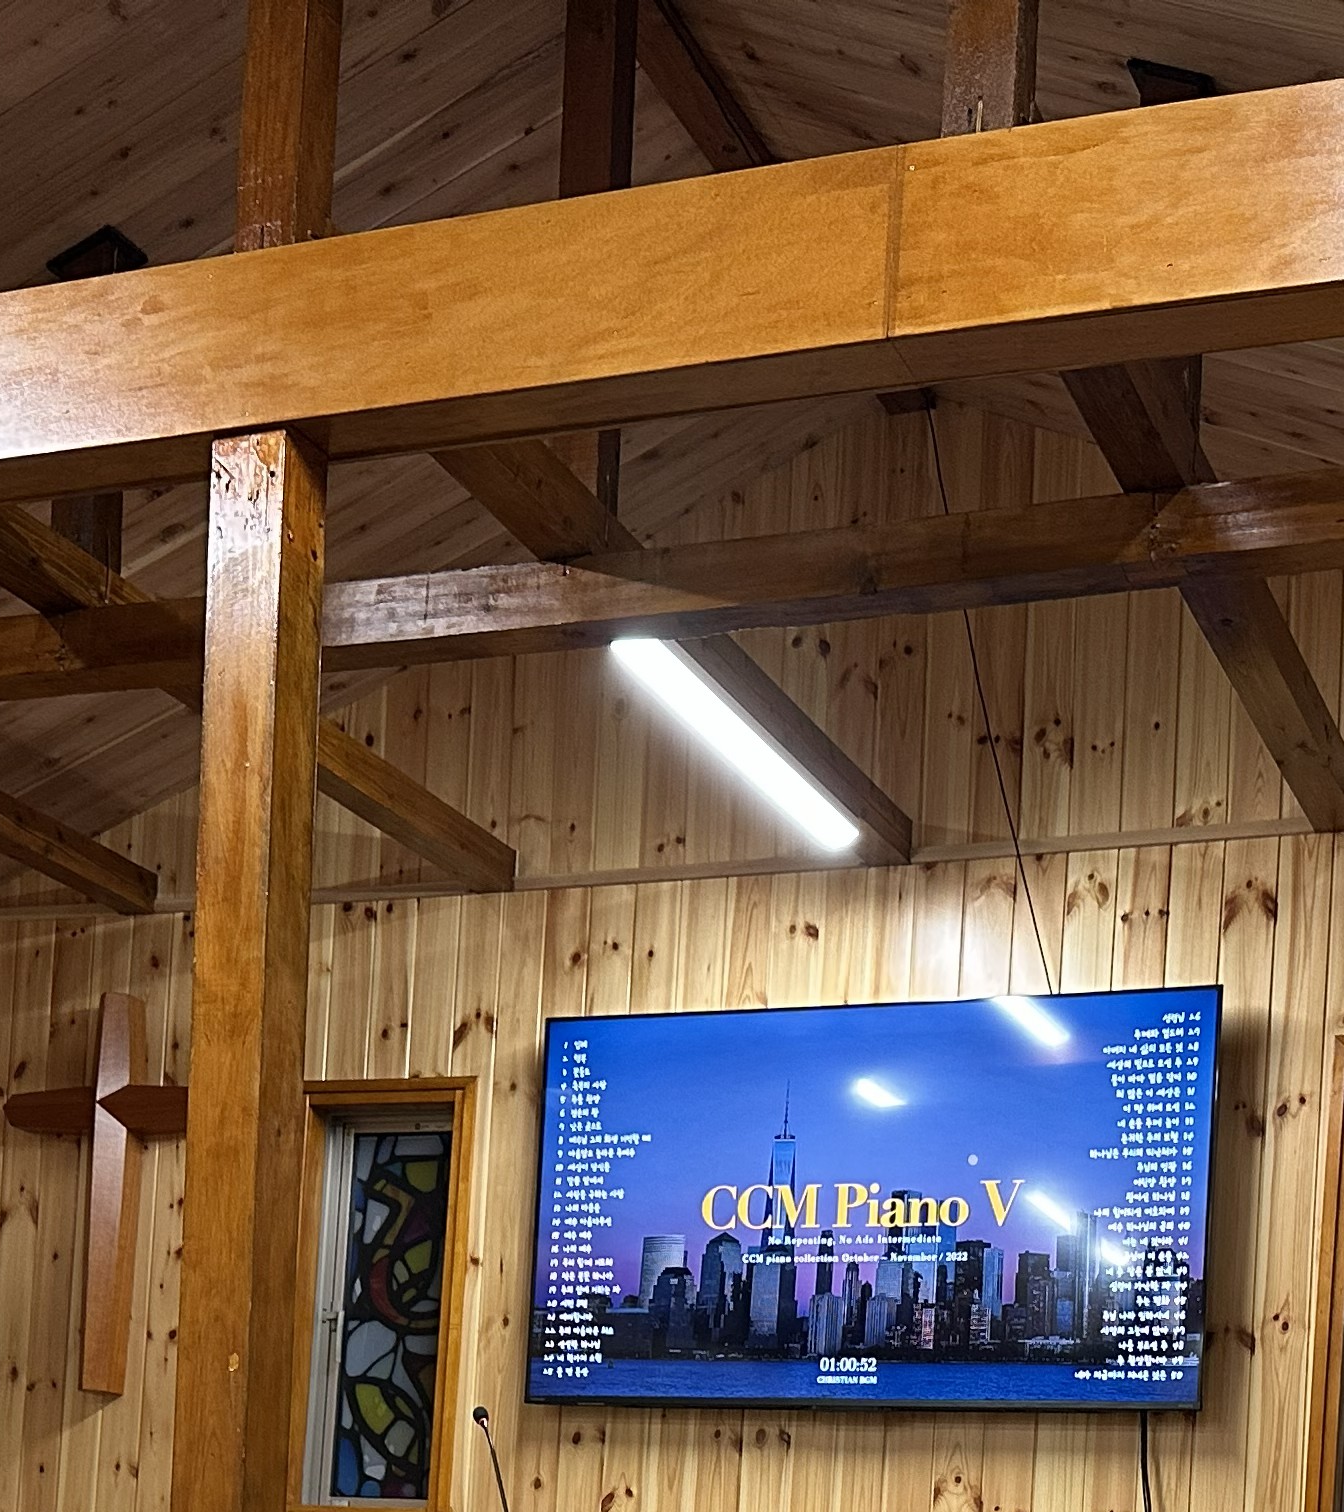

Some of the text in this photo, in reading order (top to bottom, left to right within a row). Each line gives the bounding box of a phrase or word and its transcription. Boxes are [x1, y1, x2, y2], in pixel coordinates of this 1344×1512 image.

[701, 1179, 1025, 1230] CCM Piano V
[768, 1235, 782, 1245] No
[784, 1236, 836, 1247] Repeating,
[839, 1235, 852, 1244] No
[877, 1234, 941, 1244] Intermediate
[742, 1254, 763, 1263] CCM
[766, 1254, 791, 1265] piano
[794, 1254, 839, 1263] collection
[842, 1254, 879, 1263] October
[890, 1252, 938, 1262] November
[820, 1357, 877, 1372] 01:00:52
[817, 1376, 858, 1384] CHRISTIAN
